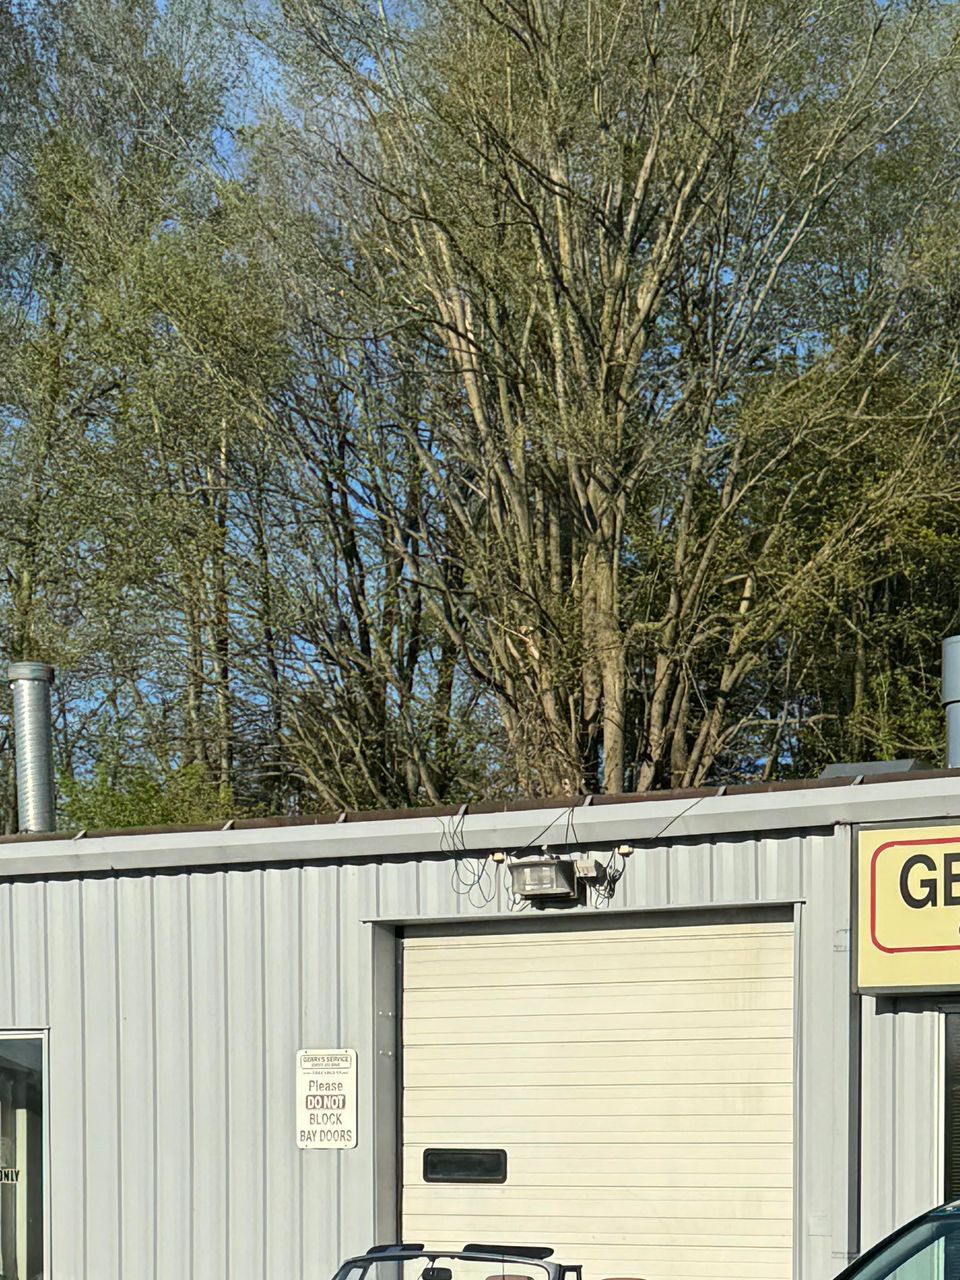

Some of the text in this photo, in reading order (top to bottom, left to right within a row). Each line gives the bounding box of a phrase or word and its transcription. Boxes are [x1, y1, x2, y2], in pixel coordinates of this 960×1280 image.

[308, 1080, 343, 1091] Please
[307, 1095, 345, 1109] DO NOT
[309, 1113, 342, 1125] BLOCK
[300, 1130, 352, 1142] BAY DOORS
